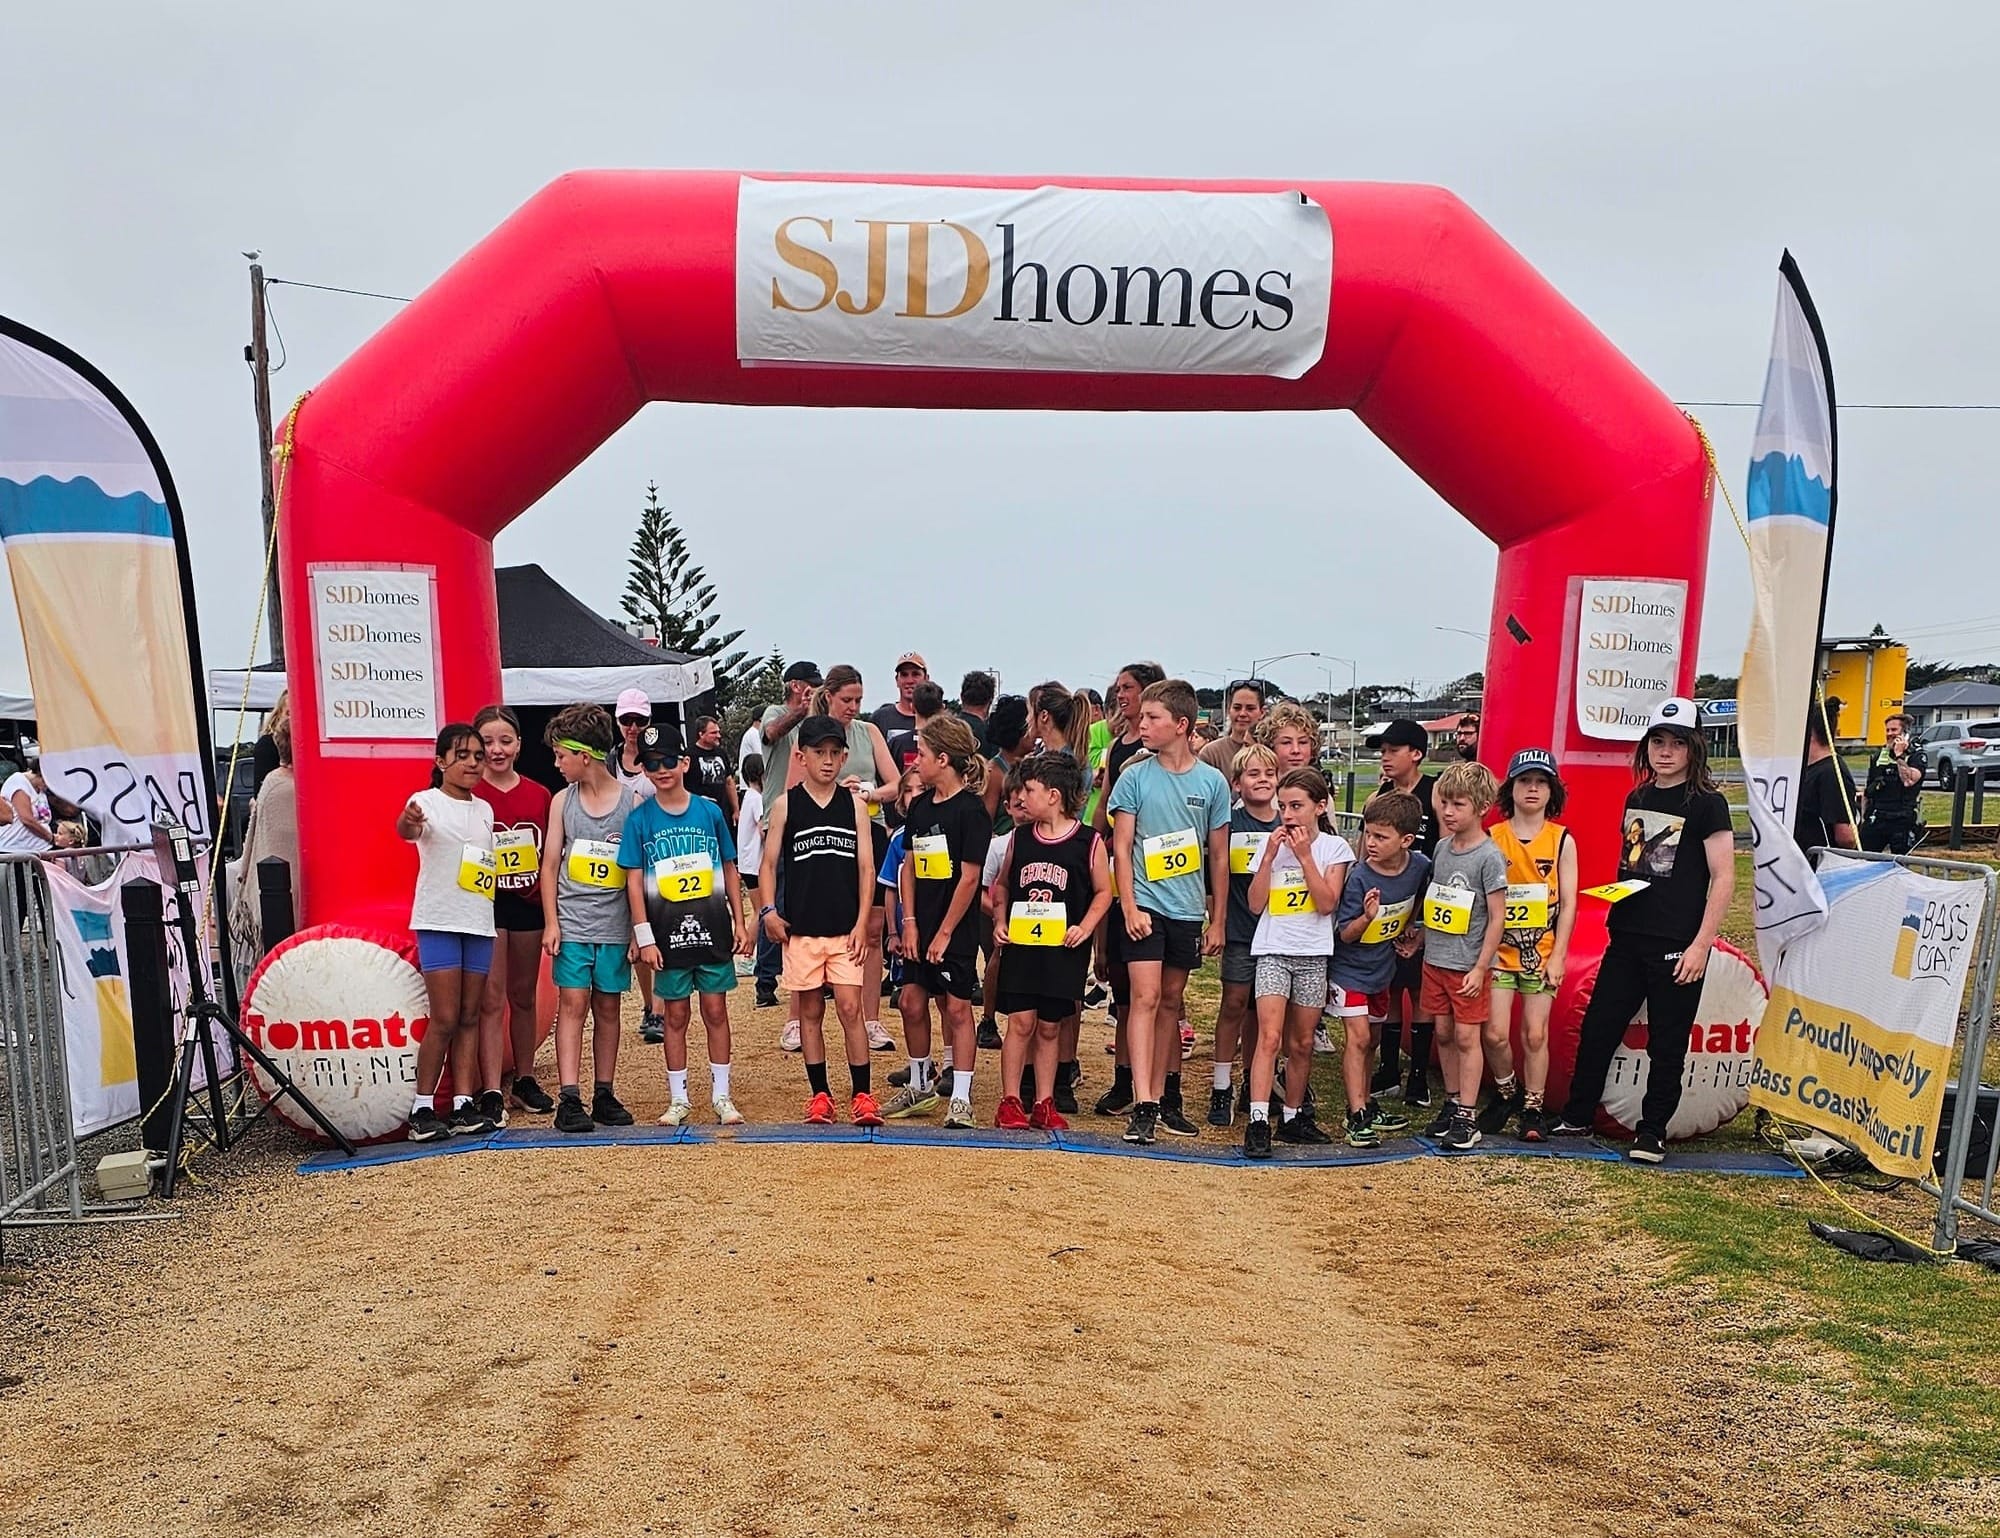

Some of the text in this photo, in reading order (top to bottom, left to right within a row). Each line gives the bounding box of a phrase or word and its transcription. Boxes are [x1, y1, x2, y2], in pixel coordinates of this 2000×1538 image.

[772, 216, 1294, 332] SJDhomes
[325, 585, 420, 606] SJDhomes
[1591, 595, 1676, 618] SJDhomes
[327, 624, 422, 644] SJDhomes
[1588, 631, 1673, 655] SJDhomes
[330, 662, 424, 682] SJDhomes
[1585, 668, 1669, 692] SJDhomes
[332, 700, 426, 719] SJDhomes
[1584, 704, 1651, 728] SJDhom
[1518, 750, 1550, 765] ITALIA
[642, 834, 720, 867] POWER
[793, 835, 826, 853] VOYAGE
[501, 851, 521, 867] 12
[1163, 852, 1187, 870] 30
[588, 862, 609, 879] 19
[1020, 862, 1068, 891] CHICAGO
[474, 871, 493, 890] 20
[678, 876, 702, 893] 22
[1286, 890, 1310, 907] 27
[1432, 906, 1453, 925] 36
[1505, 905, 1529, 921] 32
[1030, 922, 1043, 938] 4
[1380, 919, 1400, 936] 39
[1902, 1049, 1932, 1100] by
[1750, 1057, 1792, 1097] Bass
[1798, 1075, 1857, 1124] Coast
